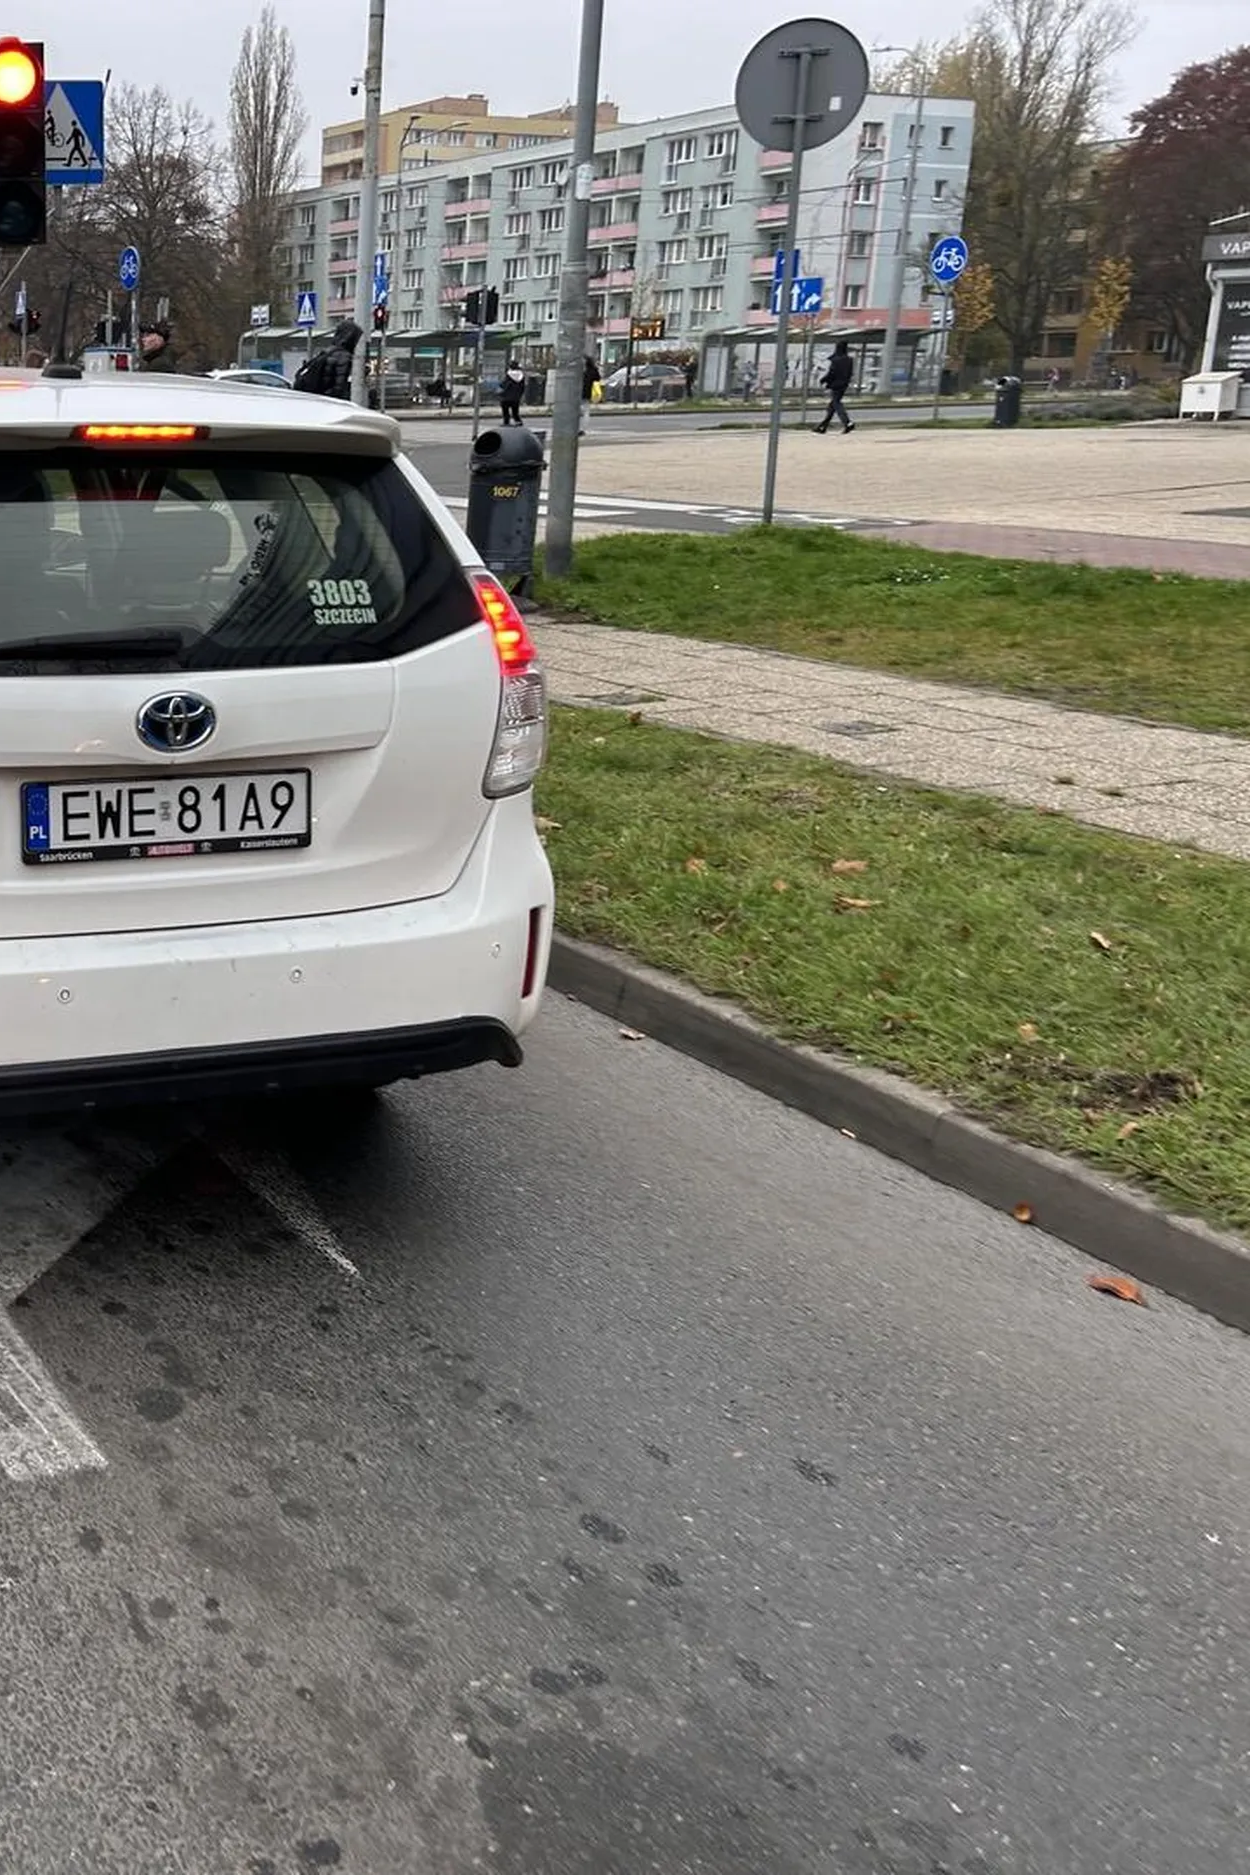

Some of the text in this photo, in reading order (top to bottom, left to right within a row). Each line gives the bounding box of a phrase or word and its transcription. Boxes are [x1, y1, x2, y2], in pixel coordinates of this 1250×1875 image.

[493, 485, 519, 498] 1067
[306, 579, 373, 606] 3803
[313, 607, 378, 625] SZCZECIN
[62, 780, 295, 841] EWE 81A9
[29, 826, 47, 840] PL
[39, 850, 93, 862] Saarbrücken
